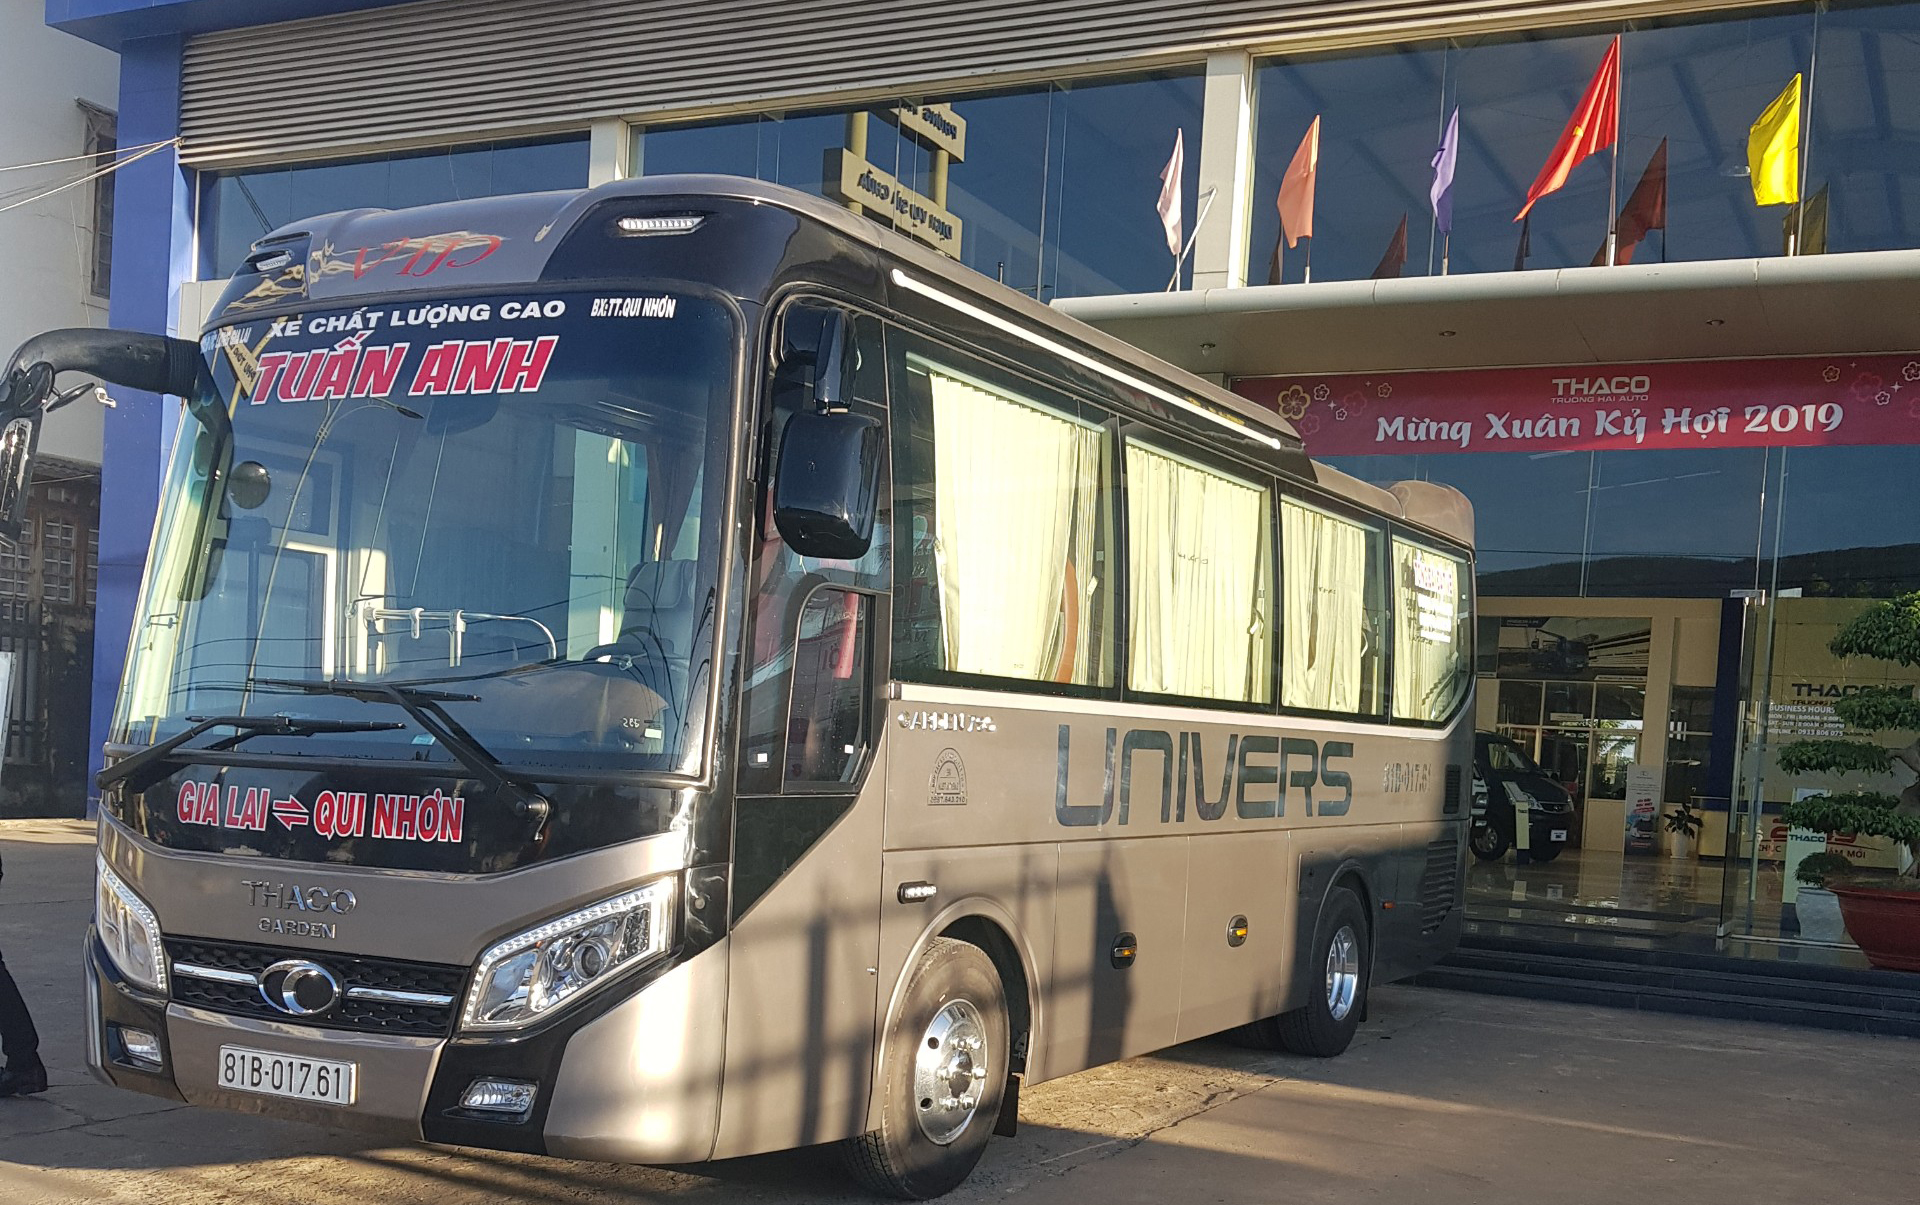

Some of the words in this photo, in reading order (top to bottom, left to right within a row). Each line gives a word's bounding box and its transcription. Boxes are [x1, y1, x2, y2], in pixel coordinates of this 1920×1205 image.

[268, 319, 303, 338] XE
[308, 306, 383, 333] CHẤT
[389, 303, 491, 328] LƯỢNG
[500, 300, 567, 320] CAO
[250, 329, 411, 406] TUẤN
[407, 335, 560, 396] ANH
[1551, 376, 1650, 396] THACO
[1597, 395, 1616, 403] HAI
[1618, 394, 1649, 402] AUTO
[1375, 416, 1473, 448] Mừng
[1484, 411, 1580, 439] Xuân
[1594, 408, 1647, 444] Kỷ
[1661, 406, 1731, 440] Hợi
[1743, 402, 1844, 433] 2019
[1055, 724, 1354, 827] UNIVERS
[177, 780, 220, 827] GIA
[224, 785, 270, 831] LAI
[313, 790, 367, 840] QUI
[371, 788, 465, 842] NHƠN
[1789, 834, 1826, 843] THACO
[241, 880, 357, 915] THACO
[259, 917, 336, 939] GARDEN
[224, 1053, 341, 1099] 81B-017.61
